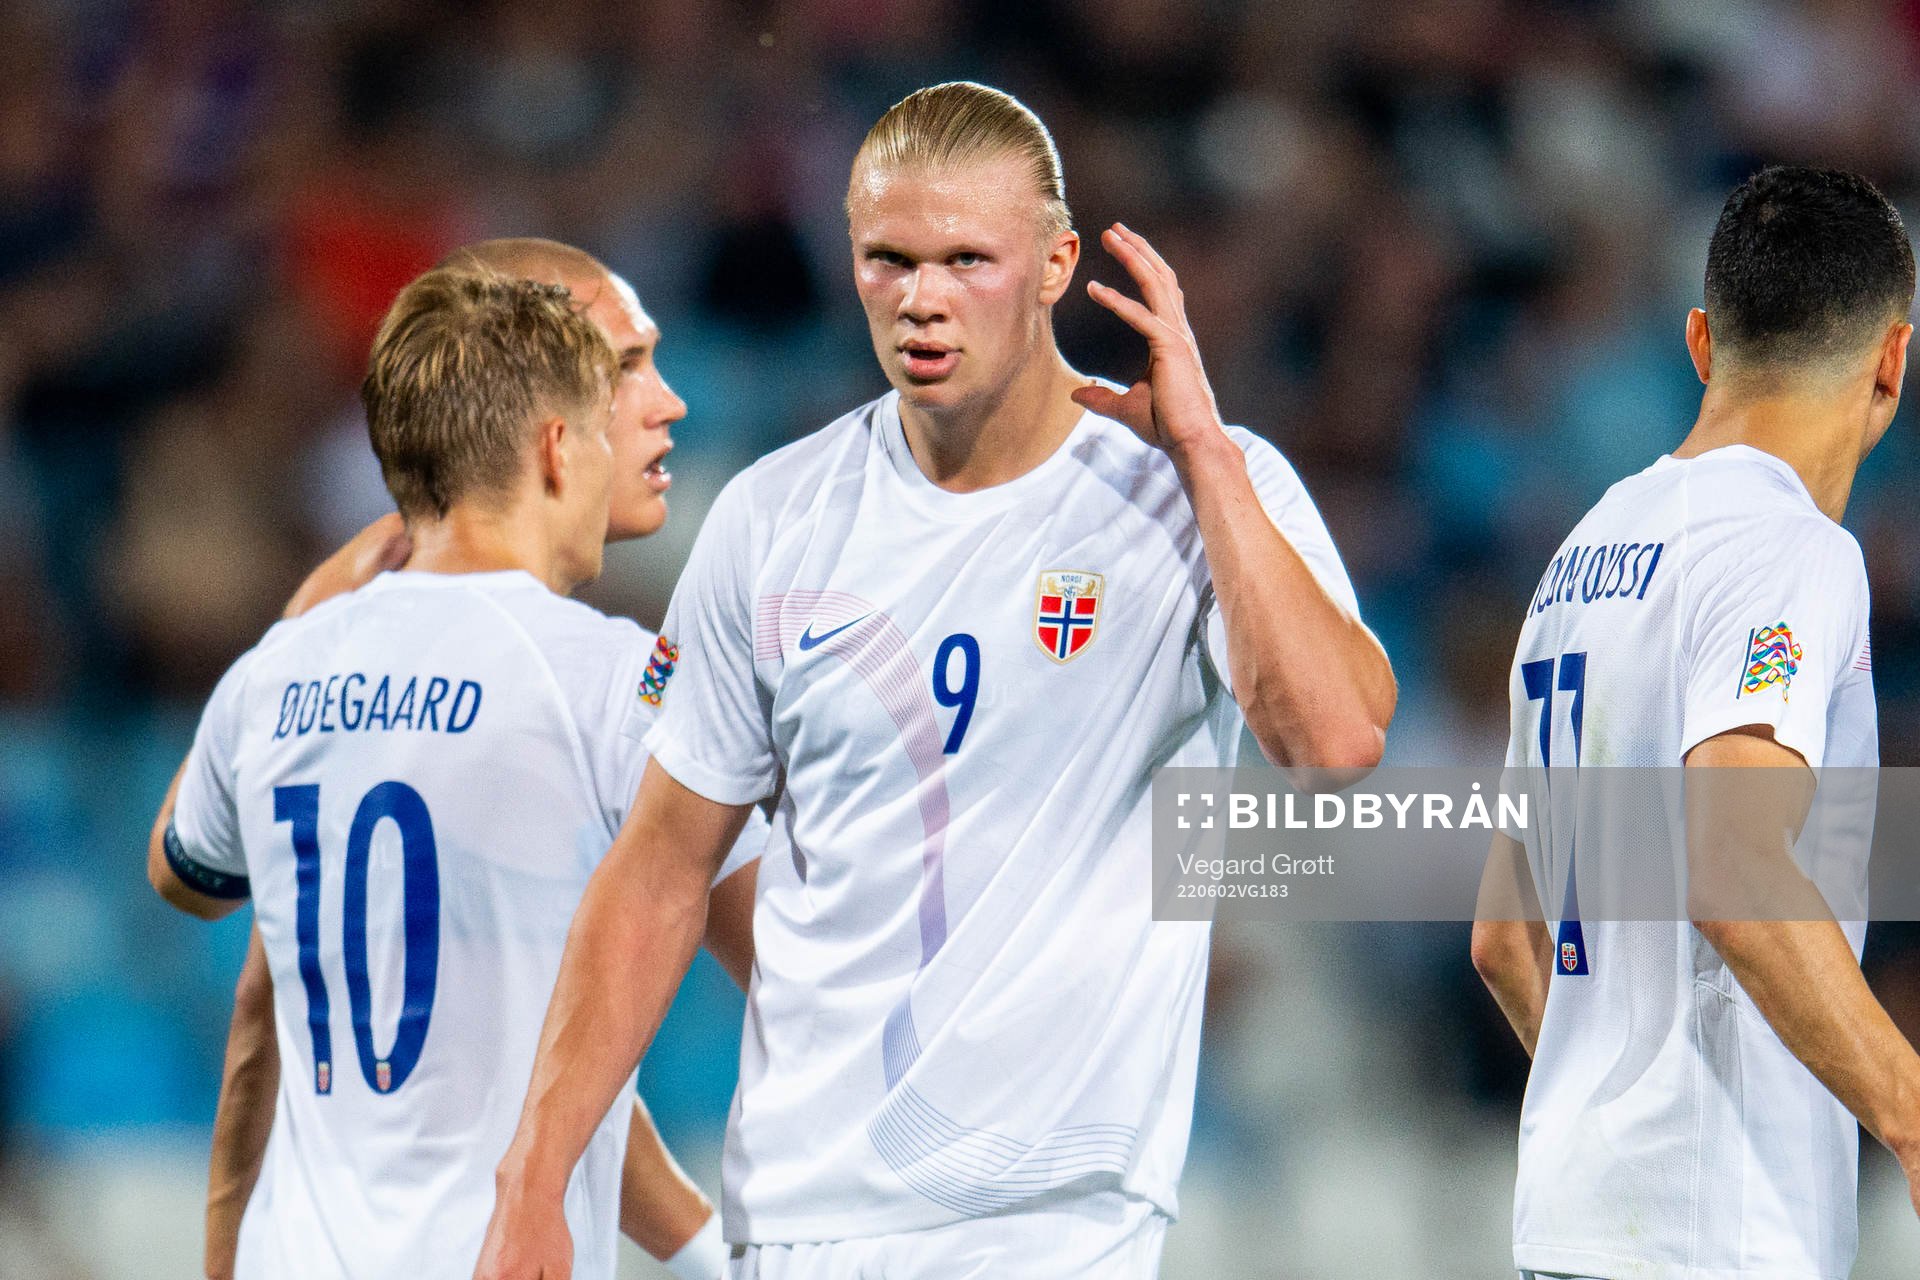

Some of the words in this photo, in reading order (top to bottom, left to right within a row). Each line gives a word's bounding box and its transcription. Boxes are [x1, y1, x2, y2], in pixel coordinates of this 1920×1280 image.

[272, 672, 483, 742] ØDEGAARD
[932, 633, 981, 754] 9
[273, 780, 441, 1095] 10
